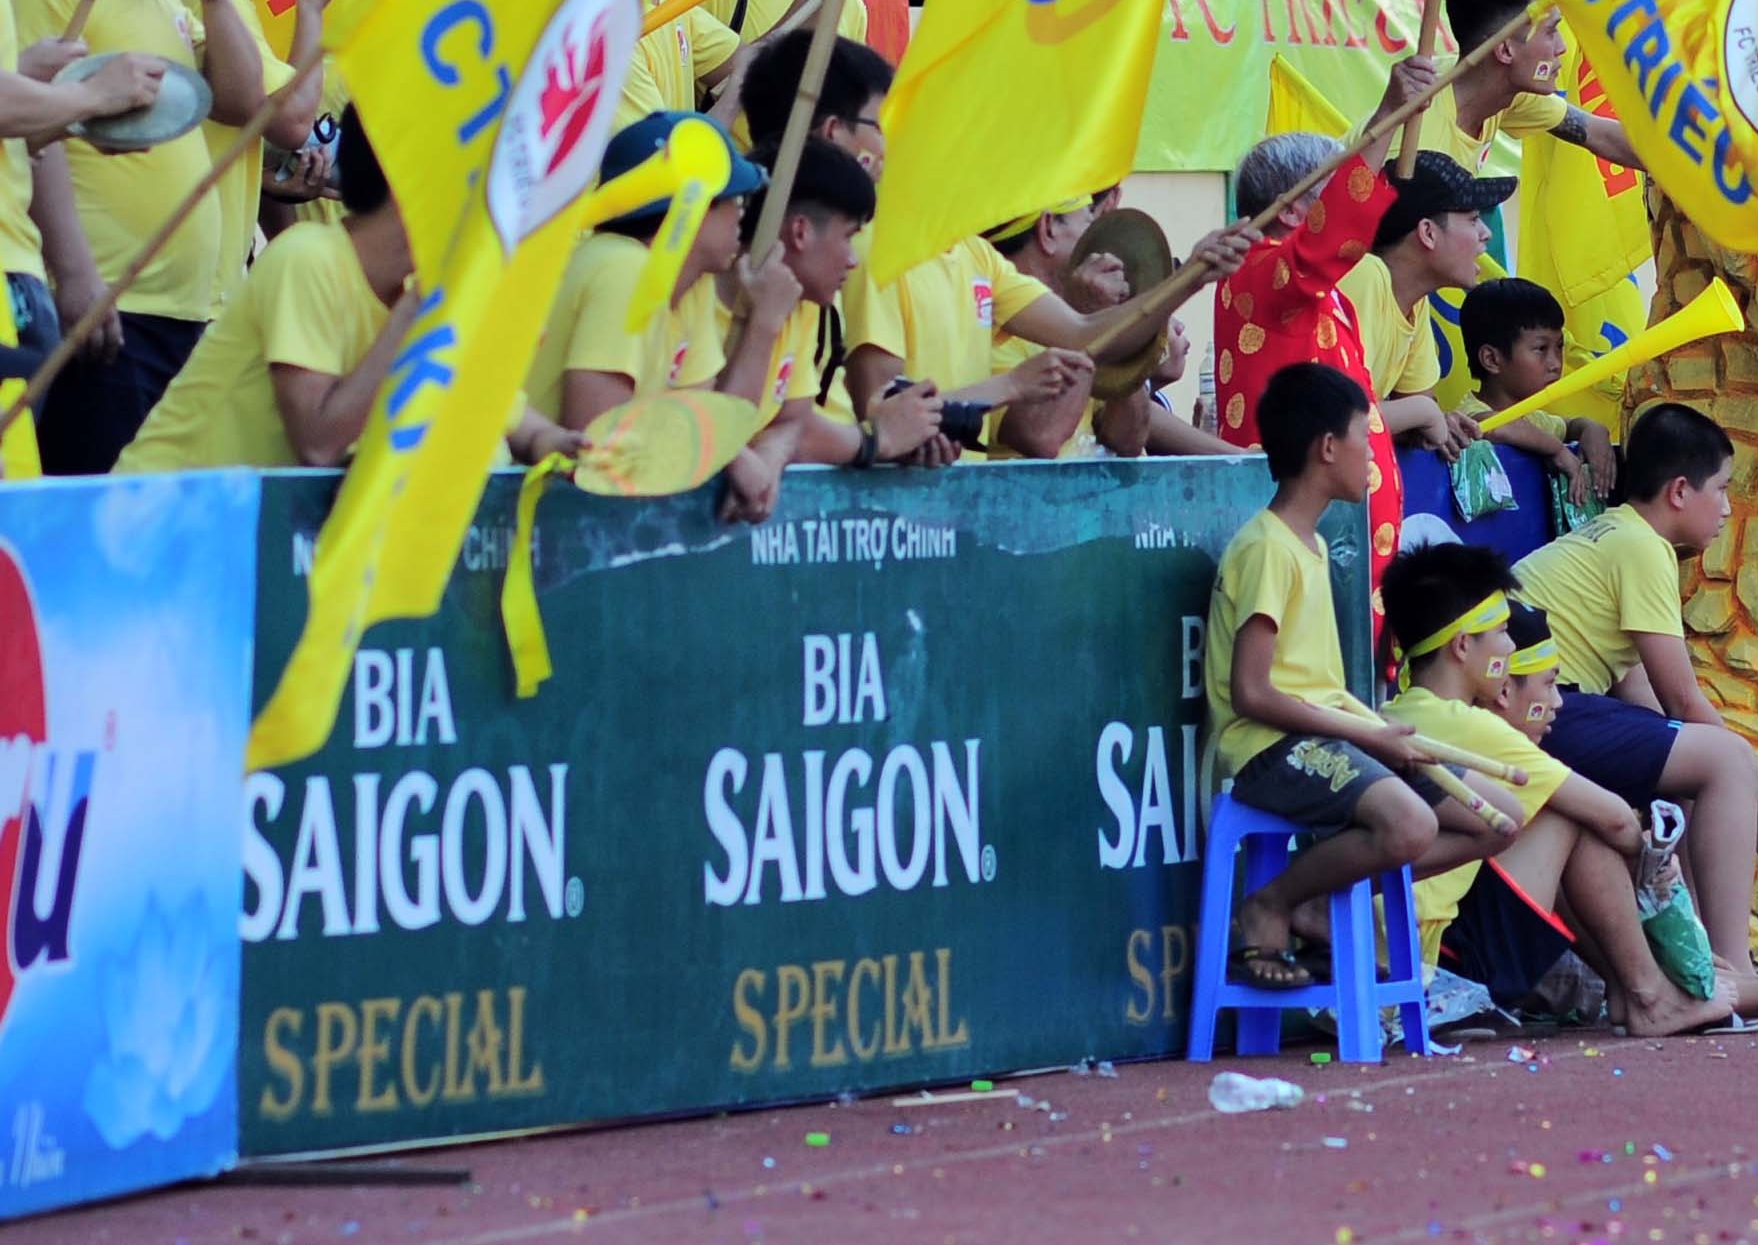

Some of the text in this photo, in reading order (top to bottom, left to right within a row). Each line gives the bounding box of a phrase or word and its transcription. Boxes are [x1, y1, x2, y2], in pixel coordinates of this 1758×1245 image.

[841, 517, 889, 571] TRỢ
[351, 646, 458, 750] BIA
[801, 630, 888, 727] BIA
[238, 762, 570, 943] SAIGON
[703, 738, 982, 907] SAIGON
[259, 985, 547, 1121] SPECIAL
[729, 947, 971, 1073] SPECIAL
